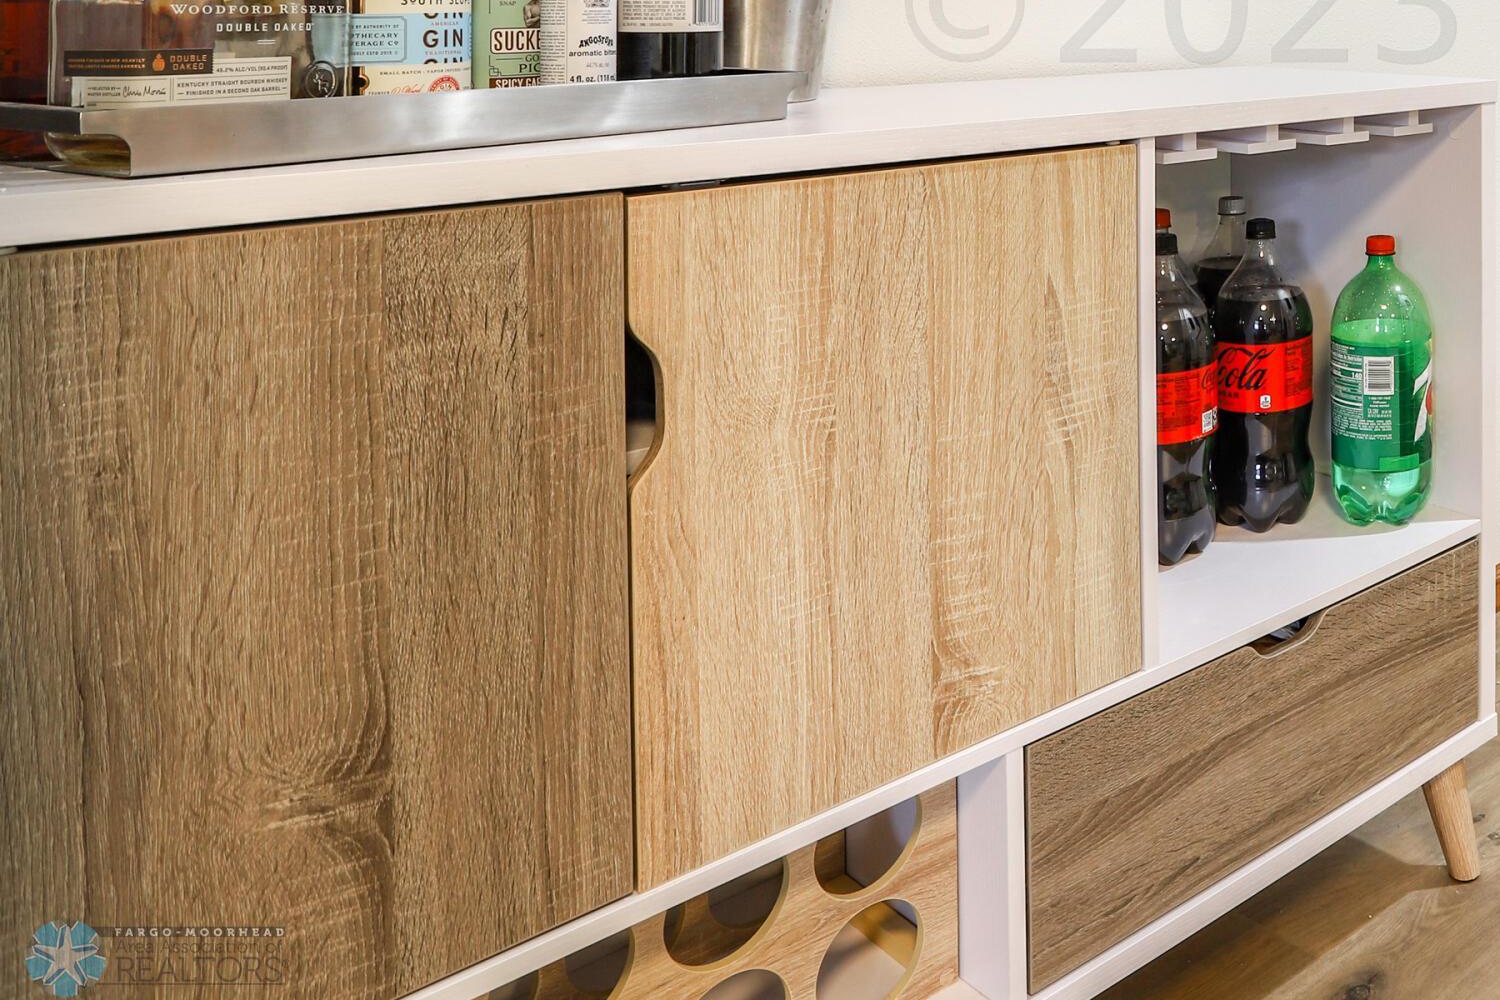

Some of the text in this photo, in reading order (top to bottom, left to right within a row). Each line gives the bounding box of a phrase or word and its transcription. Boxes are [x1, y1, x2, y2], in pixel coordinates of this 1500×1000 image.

[170, 3, 344, 15] WOODFORD RESERVE
[216, 23, 313, 32] DOUBLE OAKED
[423, 28, 463, 48] GIN
[169, 54, 208, 62] DOUBLE
[172, 62, 205, 71] OAKED
[576, 74, 584, 82] fl.
[210, 79, 238, 87] STRAIGHT
[495, 78, 523, 88] SPICY
[261, 85, 281, 93] BARREL
